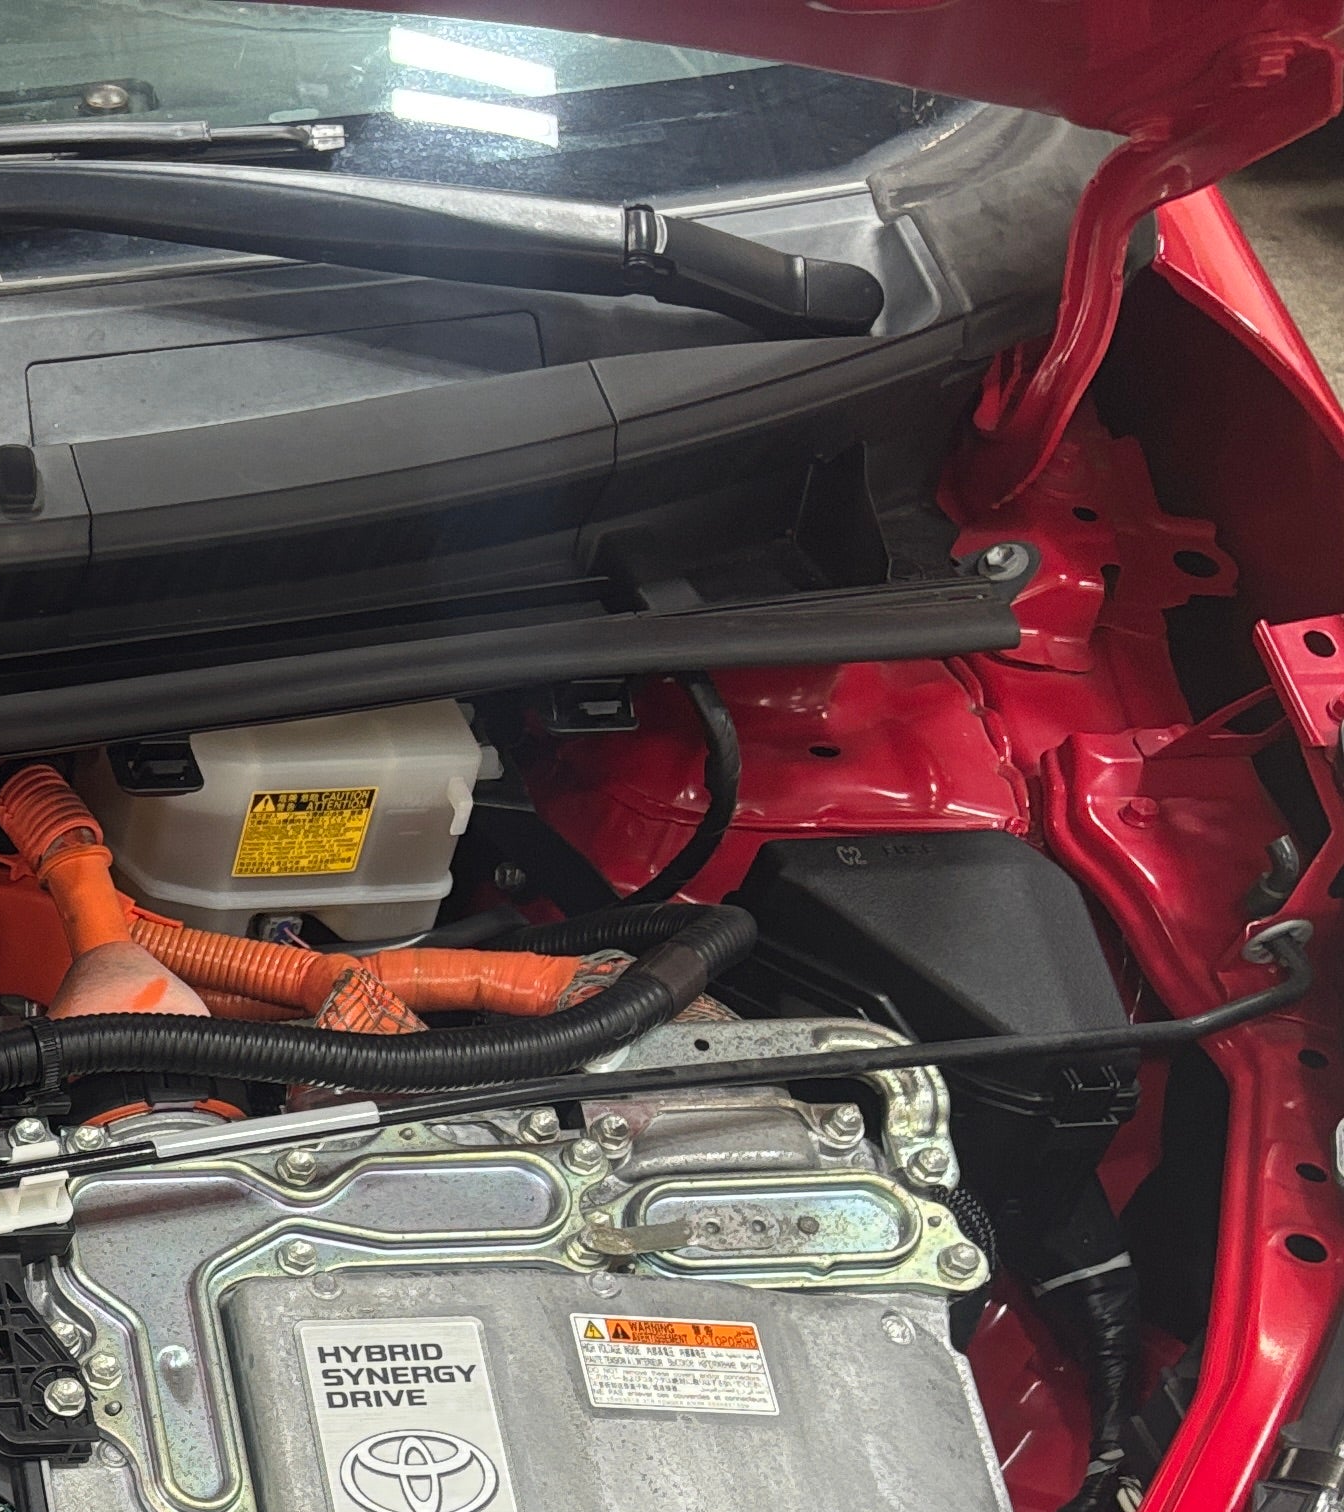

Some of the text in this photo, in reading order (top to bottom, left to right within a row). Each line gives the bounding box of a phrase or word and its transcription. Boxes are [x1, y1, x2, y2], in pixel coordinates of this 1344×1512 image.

[322, 790, 370, 802] CAUTION
[306, 799, 368, 811] ATTENTION
[629, 1321, 675, 1334] WARNING
[317, 1343, 443, 1363] HYBRID
[321, 1364, 477, 1386] SYNERGY
[326, 1389, 427, 1408] DRIVE
